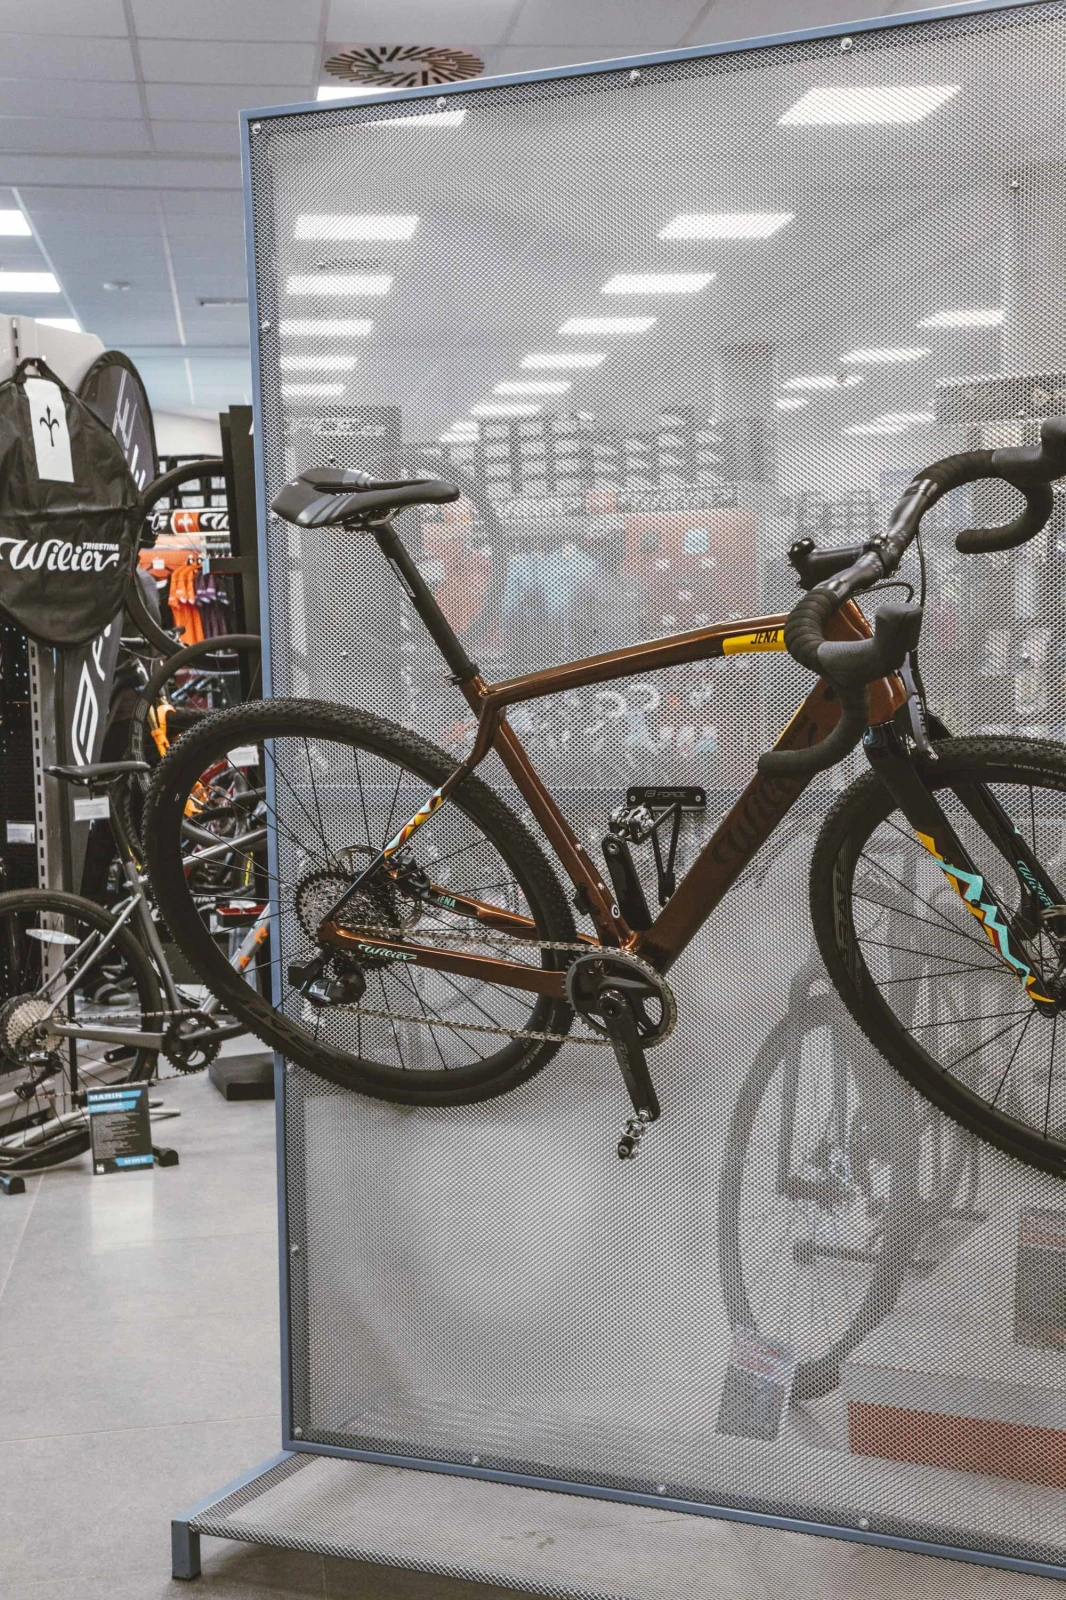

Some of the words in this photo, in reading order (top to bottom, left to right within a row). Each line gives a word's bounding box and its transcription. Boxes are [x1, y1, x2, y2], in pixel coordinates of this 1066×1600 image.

[83, 542, 119, 551] TRIESTINA
[0, 537, 120, 572] Wilier
[751, 631, 778, 645] JENA
[89, 1091, 123, 1101] MARIN
